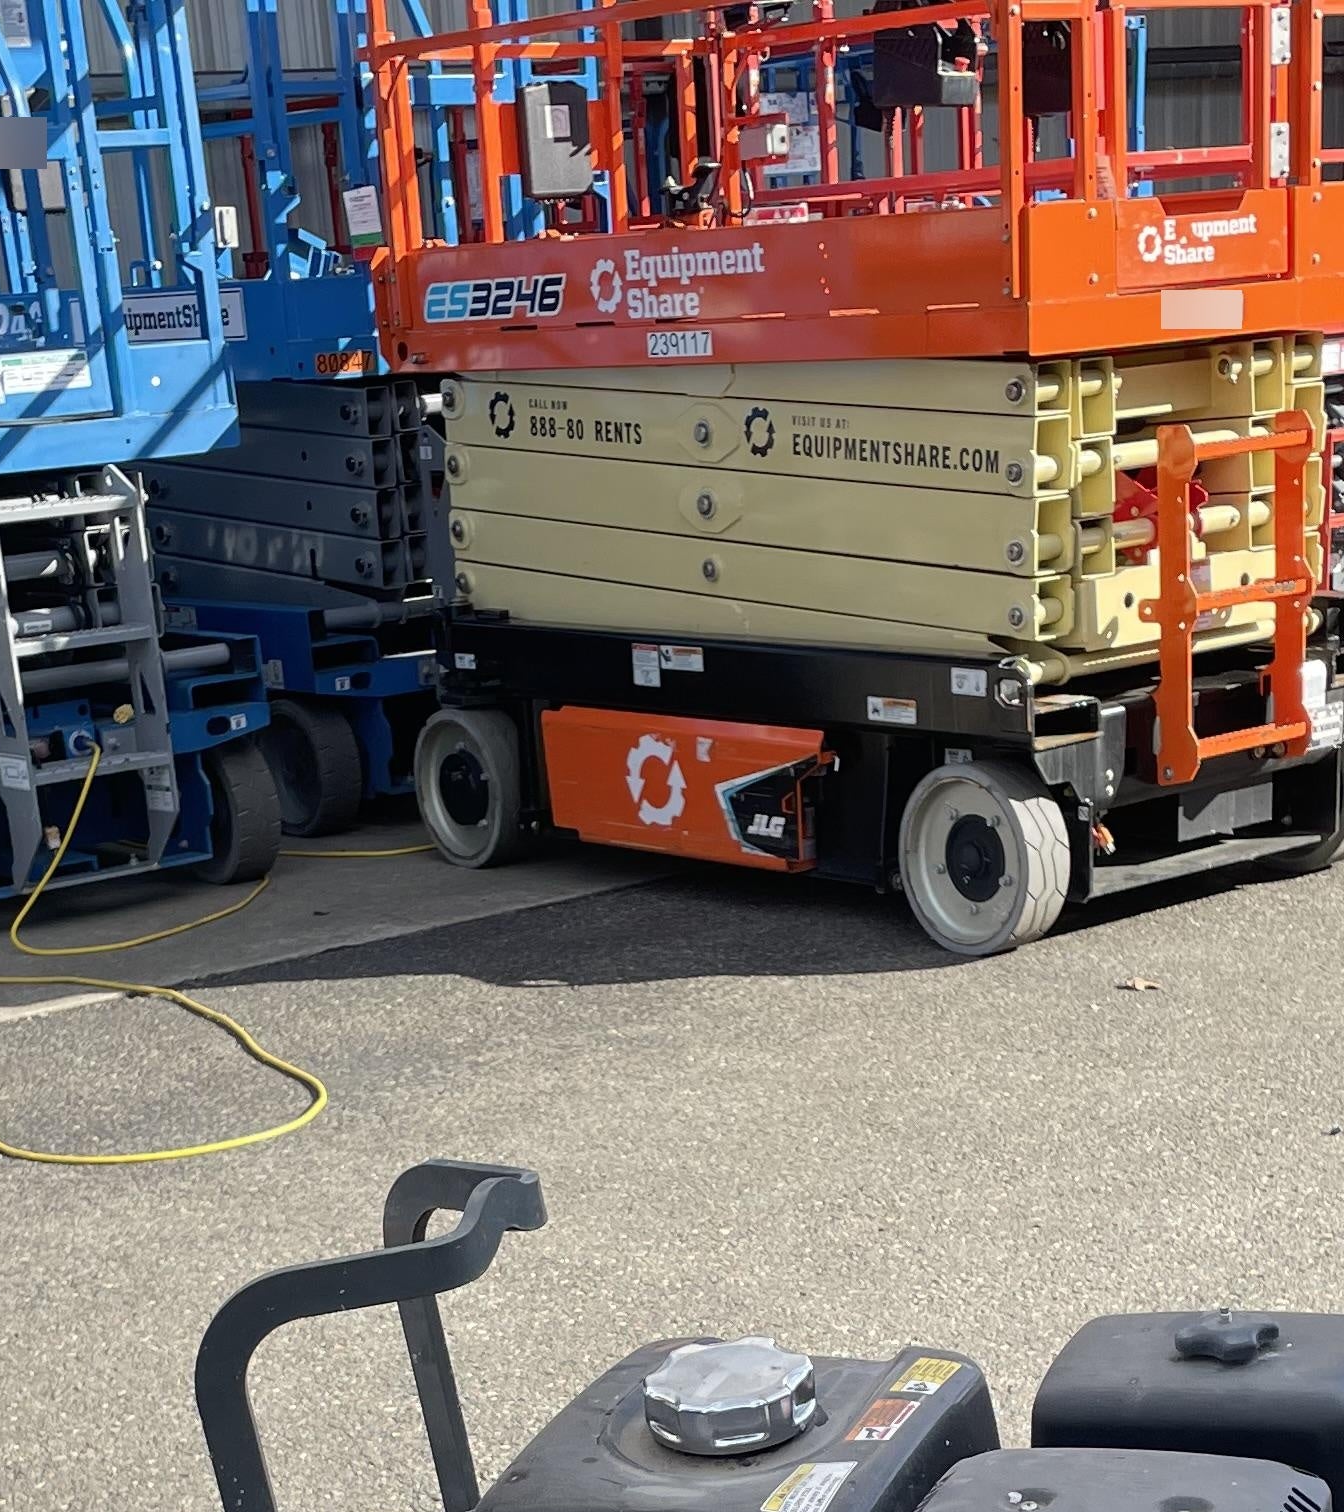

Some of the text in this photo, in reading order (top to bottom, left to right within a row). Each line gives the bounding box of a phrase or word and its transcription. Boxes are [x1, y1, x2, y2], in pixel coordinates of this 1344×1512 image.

[624, 242, 765, 286] Equipment
[1163, 244, 1215, 265] Share
[425, 274, 565, 322] ES3246
[627, 287, 700, 319] Share
[649, 331, 711, 357] 239117
[528, 398, 568, 411] CALL NOW
[529, 415, 643, 445] 888-80 RENTS
[791, 415, 817, 428] VISIT
[819, 416, 832, 429] US
[792, 433, 1000, 474] EQUIPMENTSHARE.COM
[747, 813, 786, 838] JLG
